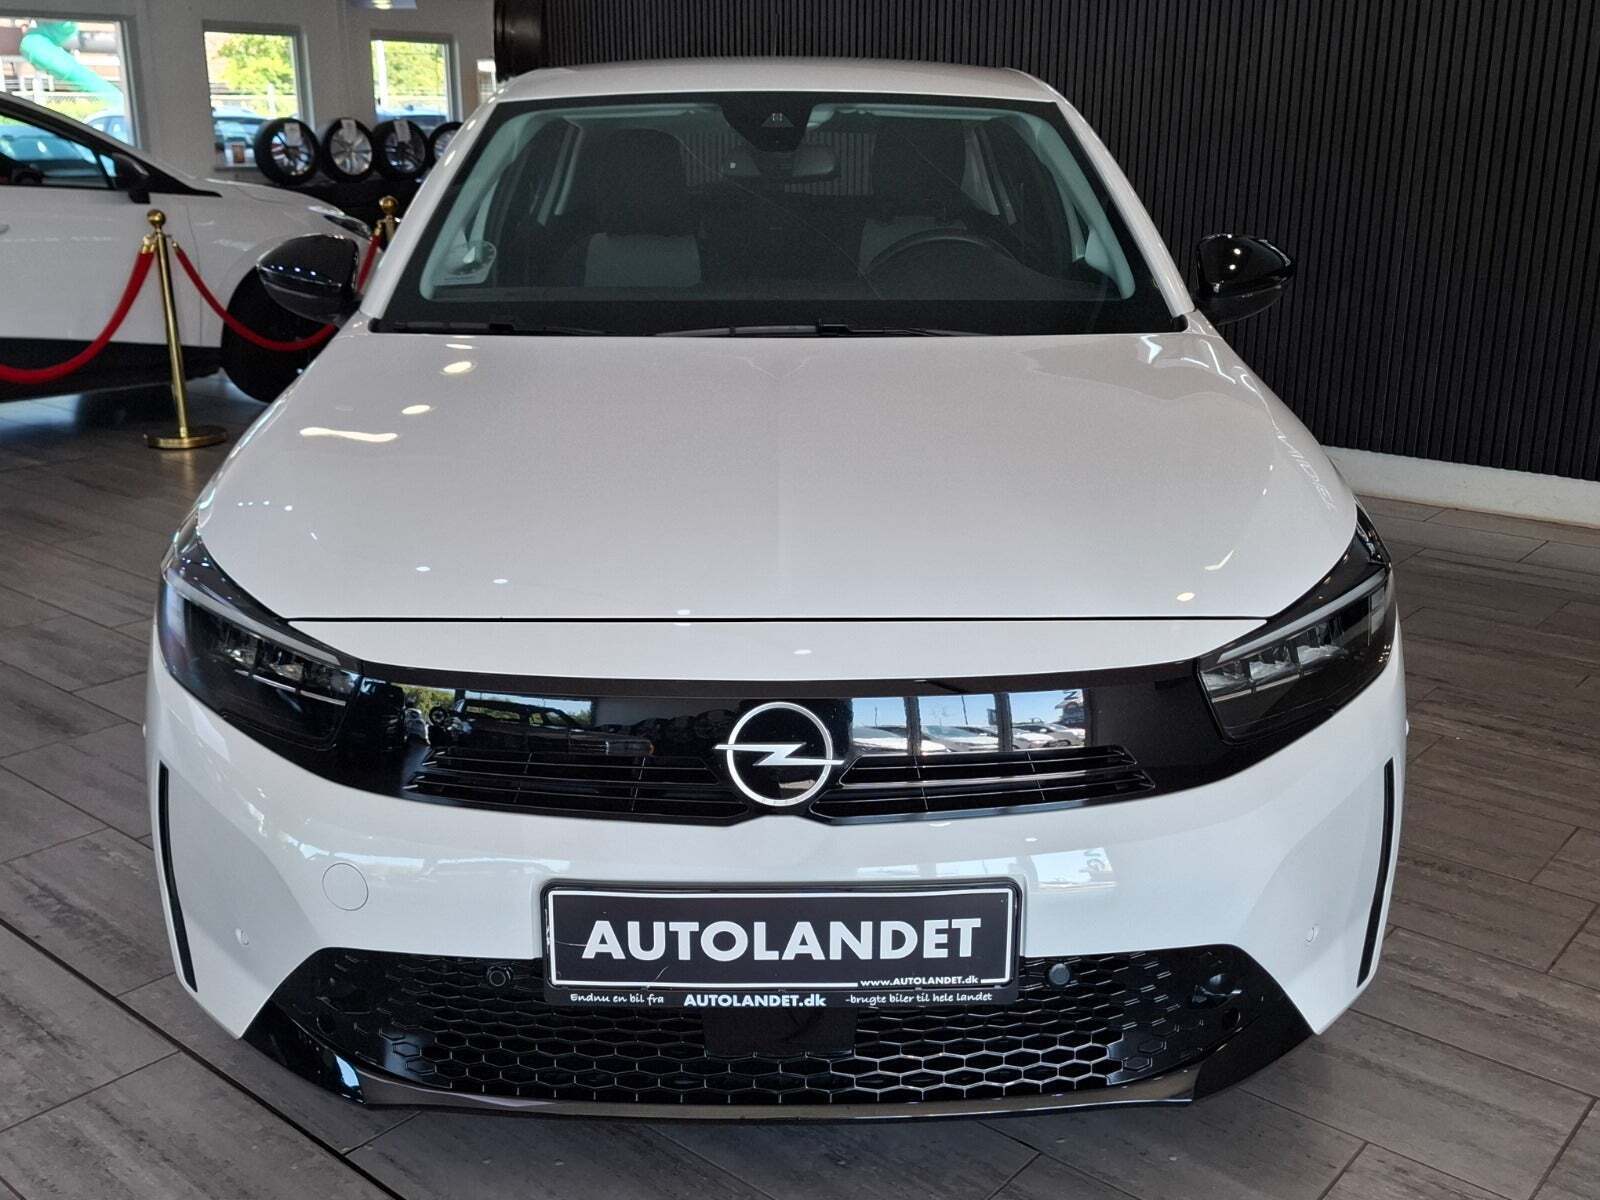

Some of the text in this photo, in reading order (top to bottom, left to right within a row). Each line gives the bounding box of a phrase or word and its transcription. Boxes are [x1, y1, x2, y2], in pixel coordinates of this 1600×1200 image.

[582, 917, 982, 961] AUTOLANDET
[860, 975, 979, 987] www.AUTOLANDET.dk
[569, 993, 664, 1006] Endnu en bil fra
[683, 993, 827, 1007] AUTOLANDET.dk
[889, 993, 915, 1003] biler
[915, 992, 930, 1002] til
[932, 992, 954, 1002] hele
[956, 991, 993, 1001] landet
